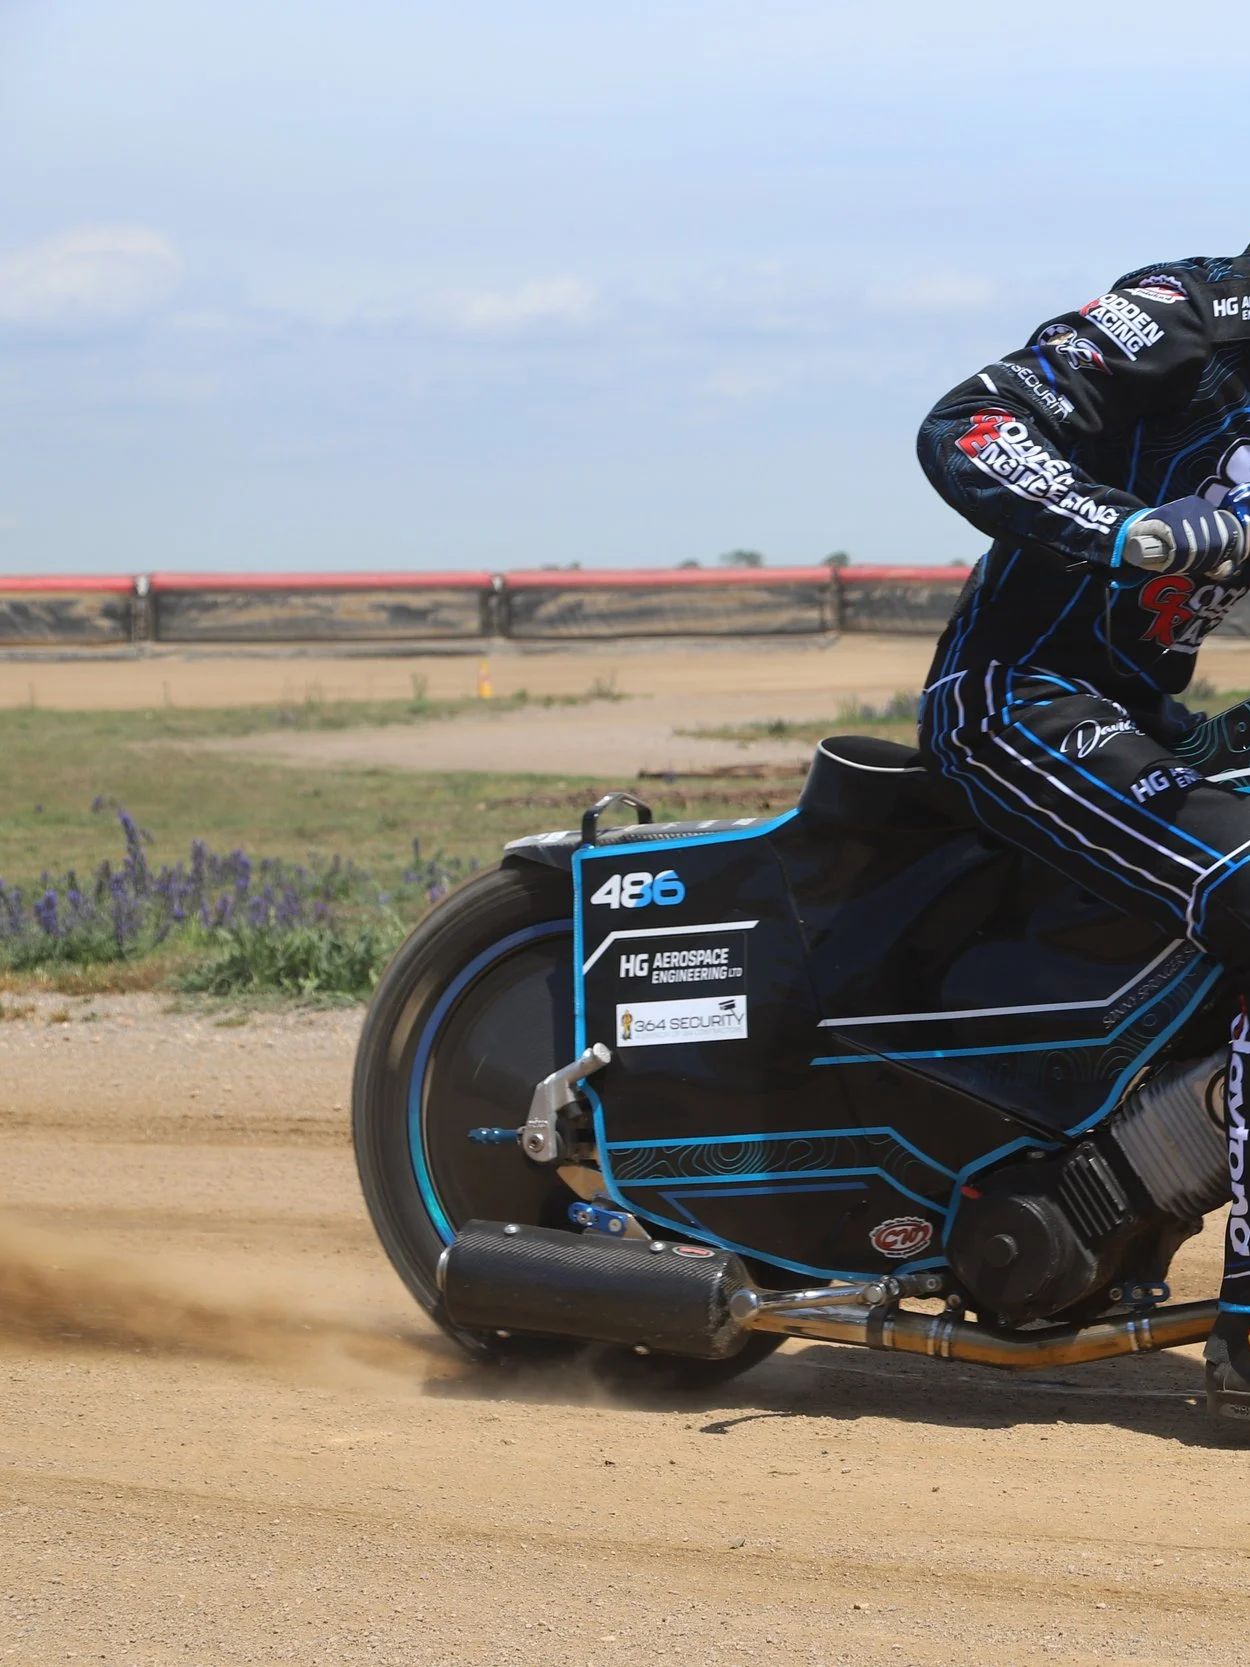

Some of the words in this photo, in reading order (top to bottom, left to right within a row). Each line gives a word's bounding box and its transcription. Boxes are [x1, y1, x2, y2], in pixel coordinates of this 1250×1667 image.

[1099, 293, 1165, 344] ODDEN
[1212, 296, 1239, 317] HG
[1130, 769, 1171, 803] HG
[590, 870, 686, 909] 486
[619, 953, 650, 978] HG
[652, 948, 730, 968] AEROSPACE
[651, 966, 728, 984] ENGINEERING
[728, 967, 743, 978] LTD
[634, 1019, 667, 1033] 364
[669, 1012, 745, 1030] SECURITY
